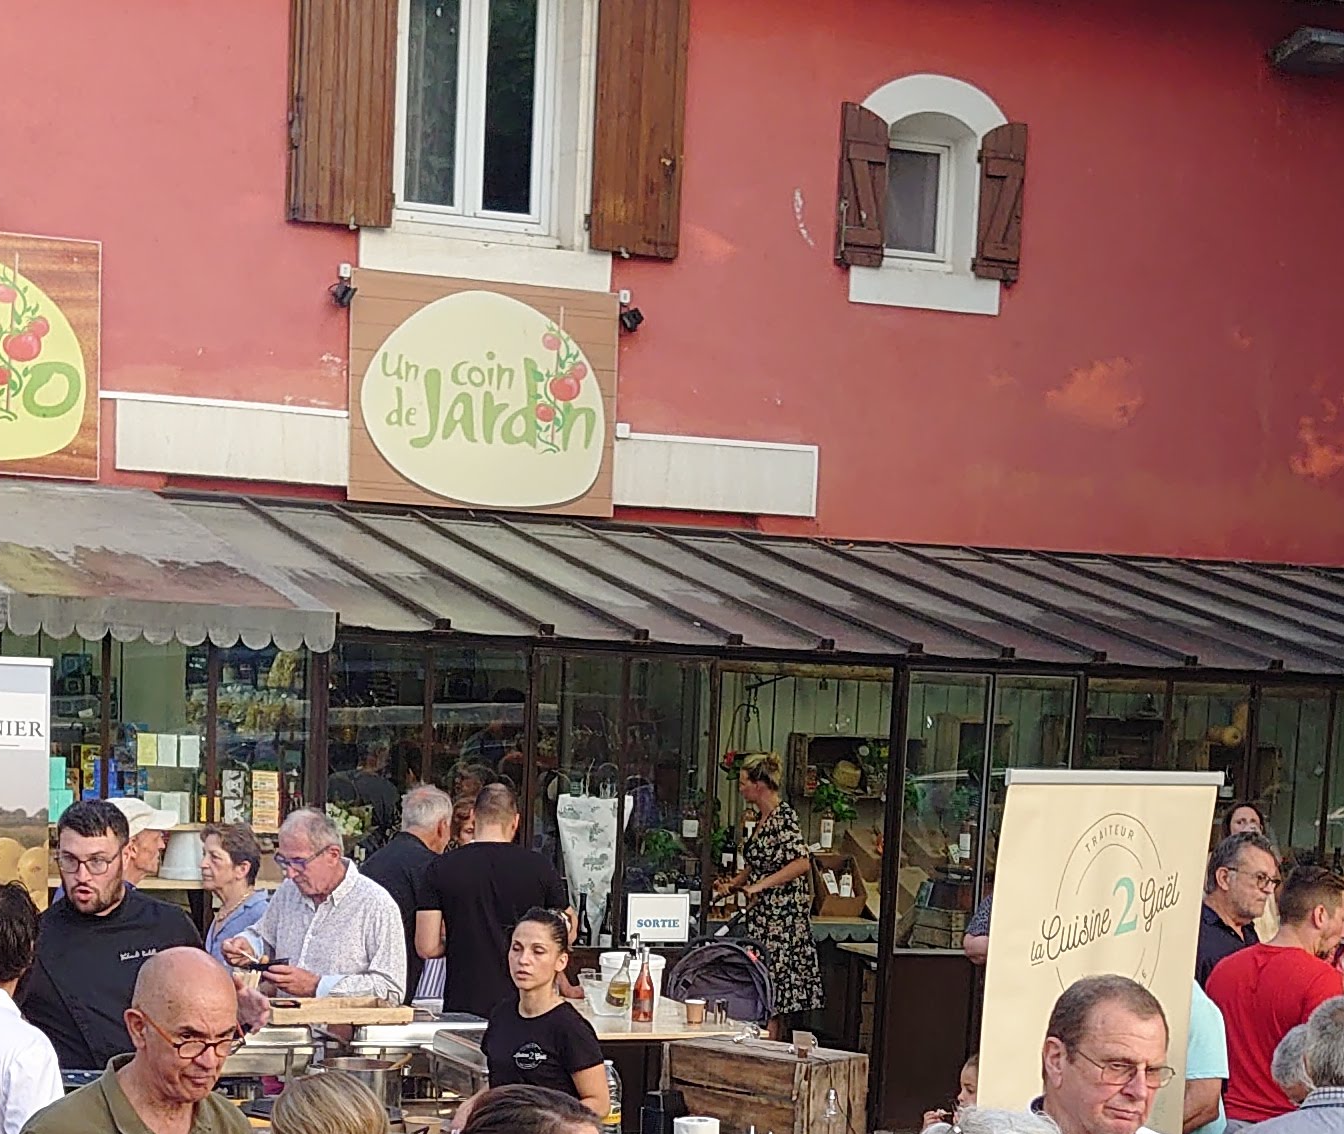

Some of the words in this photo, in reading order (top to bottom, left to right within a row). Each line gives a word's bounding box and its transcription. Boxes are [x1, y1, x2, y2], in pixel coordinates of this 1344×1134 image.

[380, 351, 419, 383] Un
[450, 351, 516, 391] coin
[384, 386, 417, 427] de
[409, 357, 597, 452] Jardin
[1085, 824, 1136, 854] TRAITEUR
[636, 918, 680, 928] SORTIE
[1030, 940, 1045, 965] la
[1041, 908, 1113, 961] Cuisine
[1112, 876, 1139, 937] 2
[1139, 872, 1181, 933] Gaël
